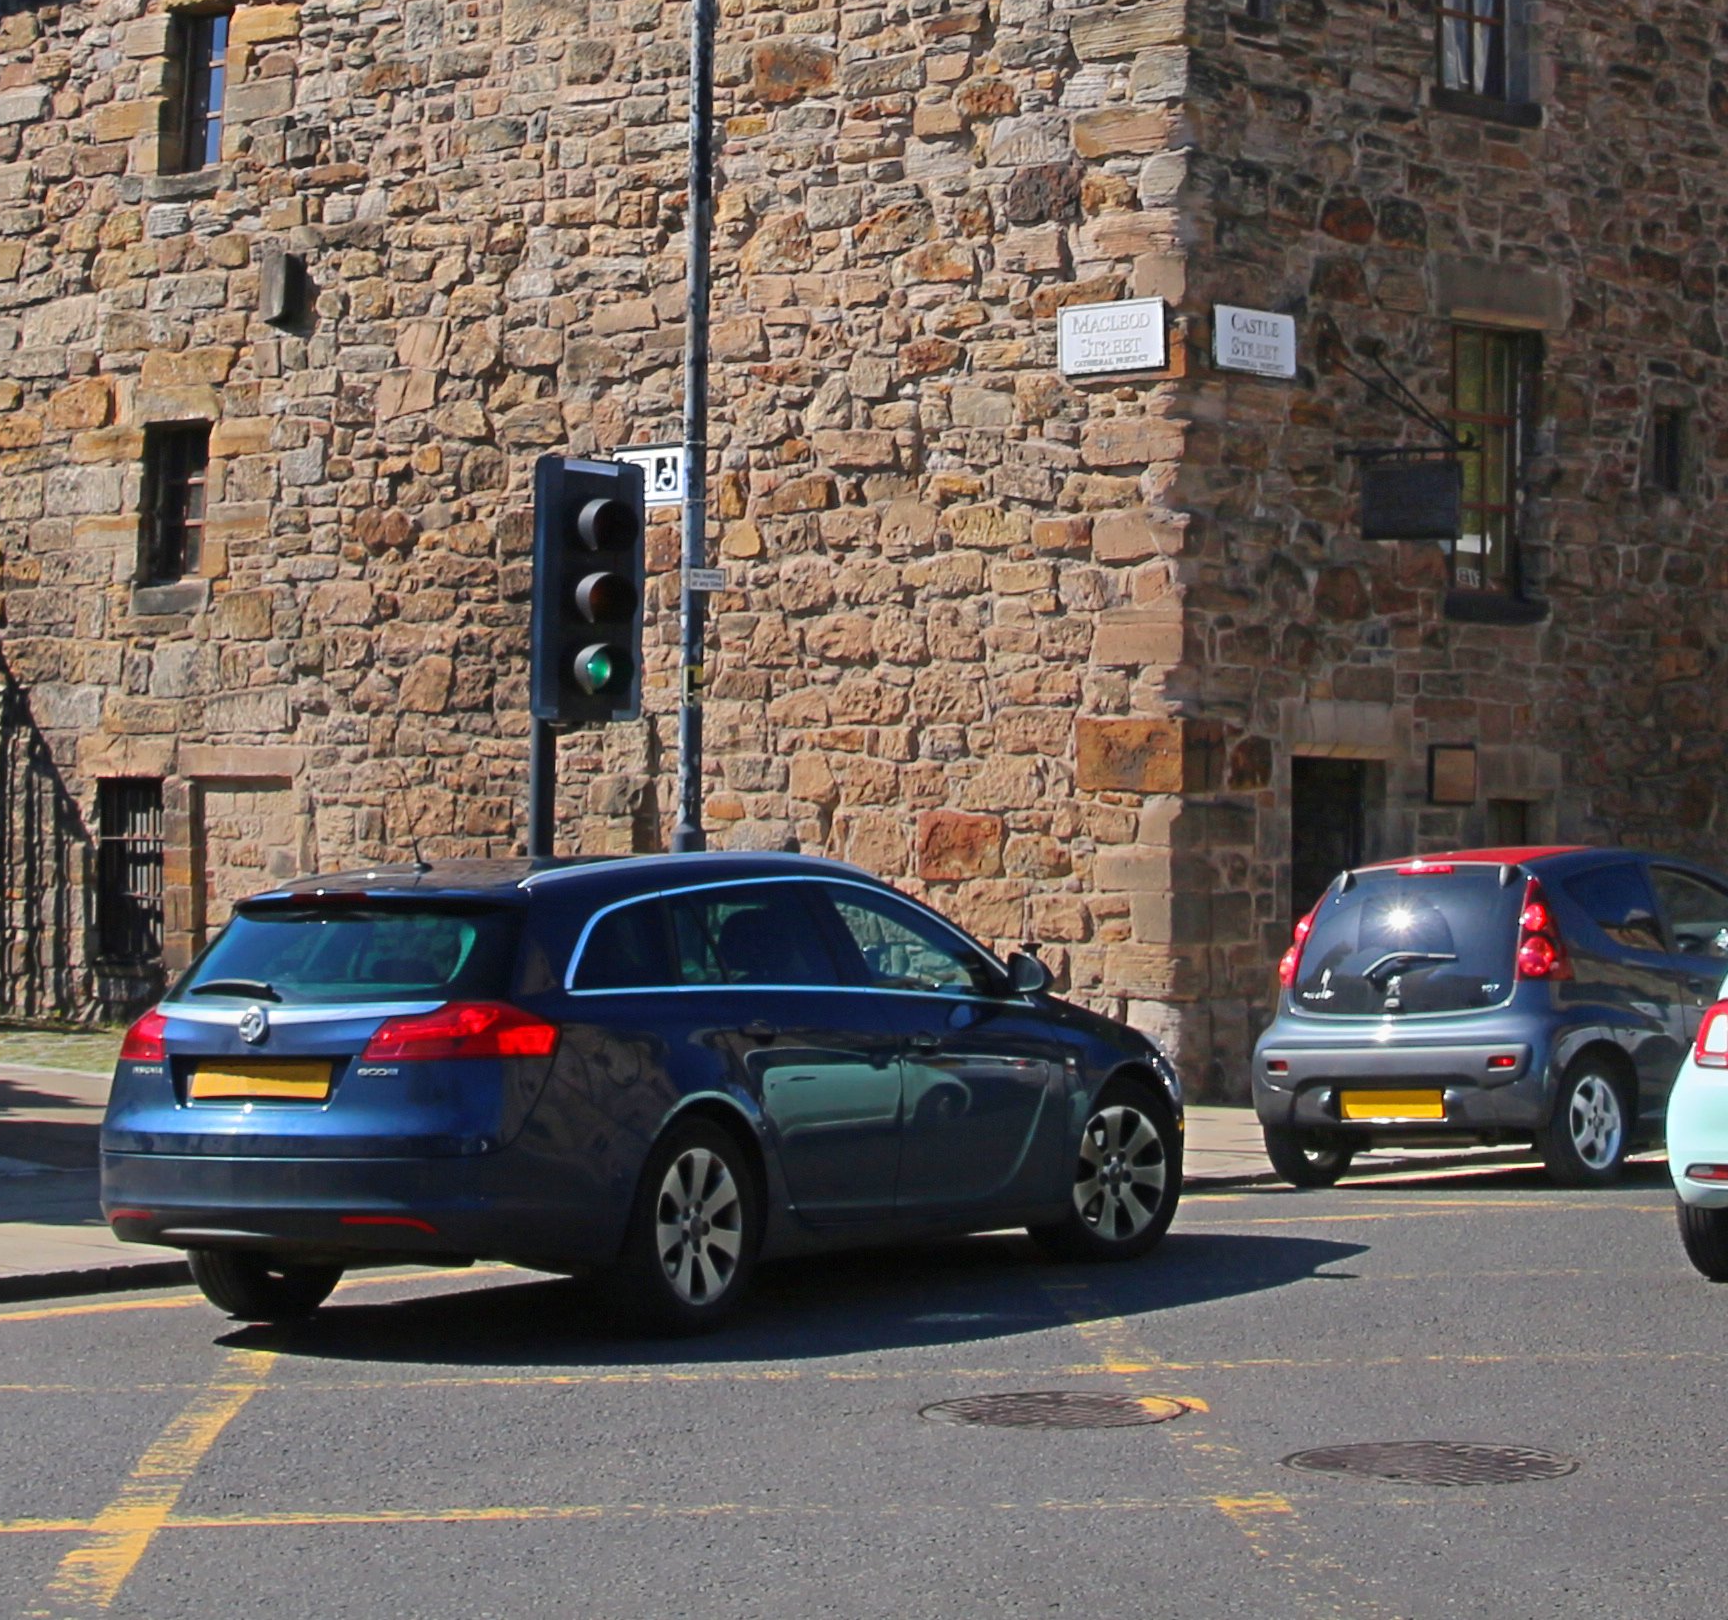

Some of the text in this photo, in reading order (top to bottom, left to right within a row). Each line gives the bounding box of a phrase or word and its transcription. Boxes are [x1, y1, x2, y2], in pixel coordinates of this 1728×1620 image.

[1071, 312, 1151, 335] MACLEOD
[1231, 312, 1280, 338] CASTLE
[1080, 337, 1143, 359] STREET
[1231, 336, 1279, 361] STREET
